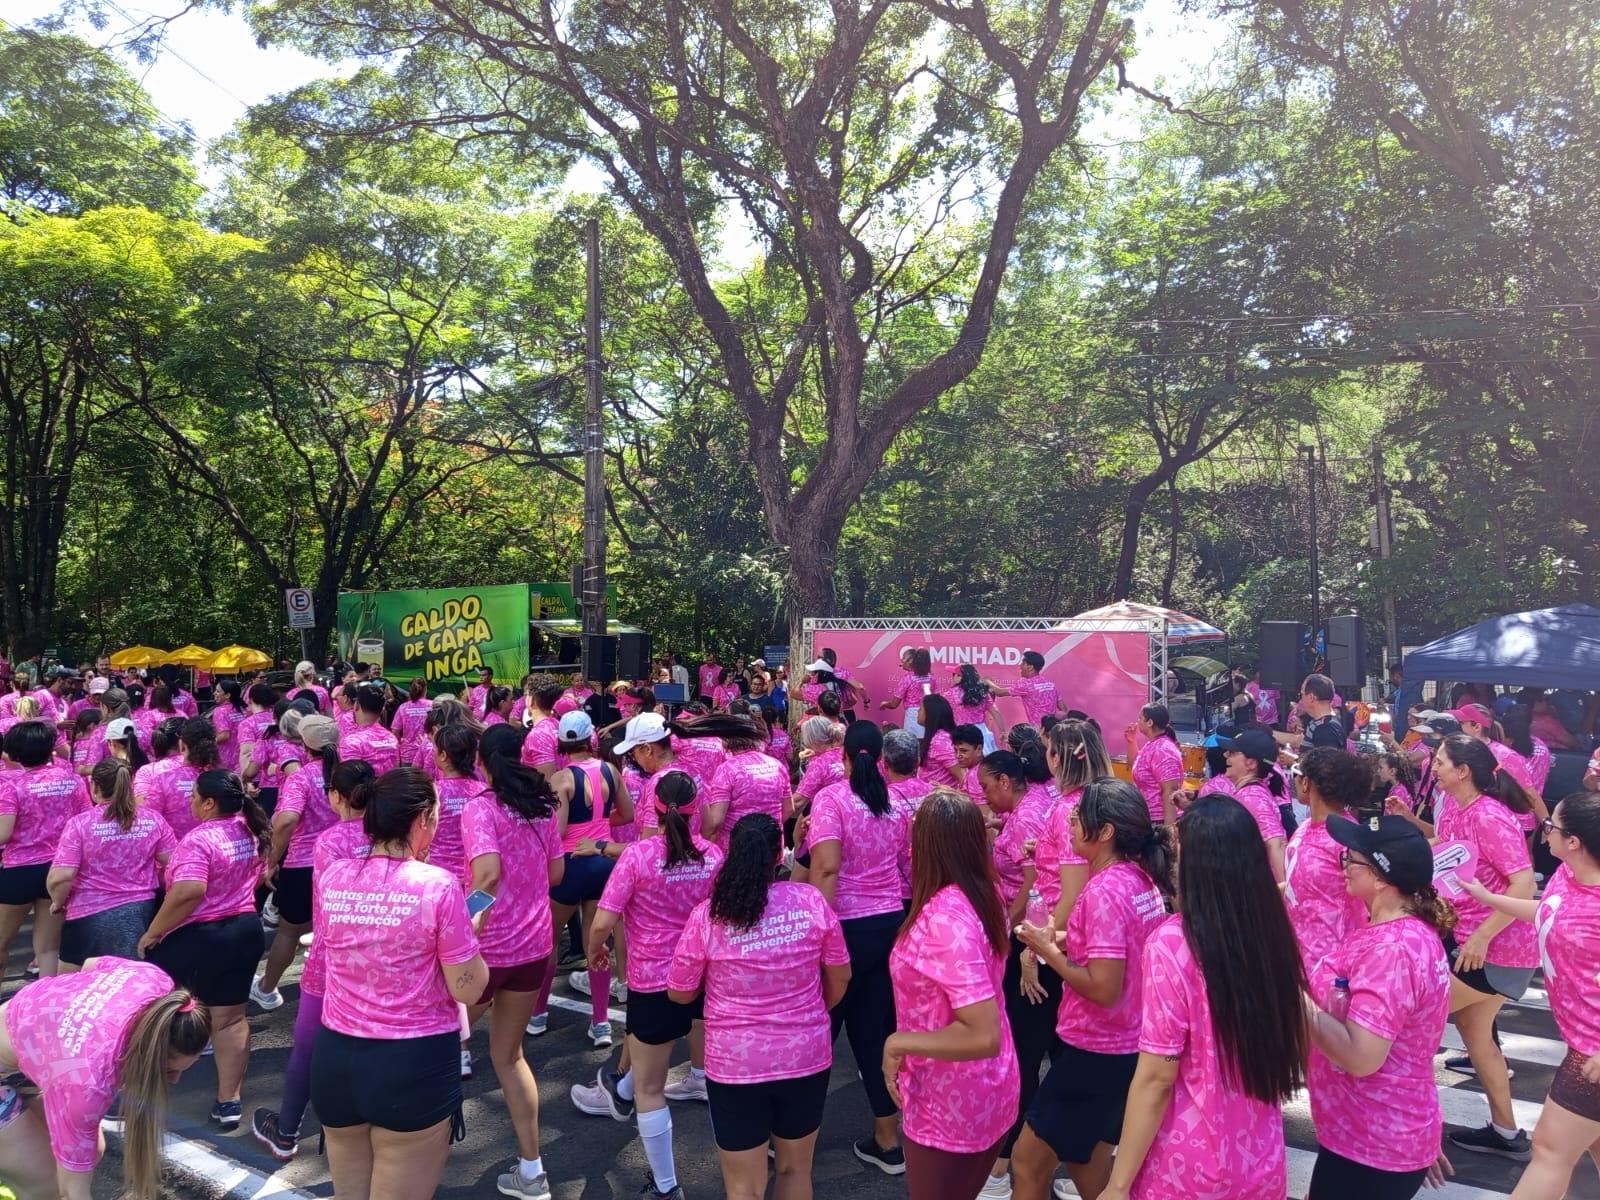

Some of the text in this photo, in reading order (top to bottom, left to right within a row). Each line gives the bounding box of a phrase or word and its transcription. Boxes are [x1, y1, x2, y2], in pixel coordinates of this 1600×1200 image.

[295, 594, 305, 607] E
[401, 595, 481, 637] CALDO
[404, 617, 492, 661] DE CANA
[425, 640, 483, 681] INGÁ
[323, 888, 421, 906] Juntas na luta,
[323, 901, 412, 915] mais forte na
[769, 915, 785, 926] na
[788, 909, 813, 922] luta,
[328, 913, 401, 929] prevenção
[730, 921, 810, 946] mais forte na
[741, 931, 806, 956] prevenção
